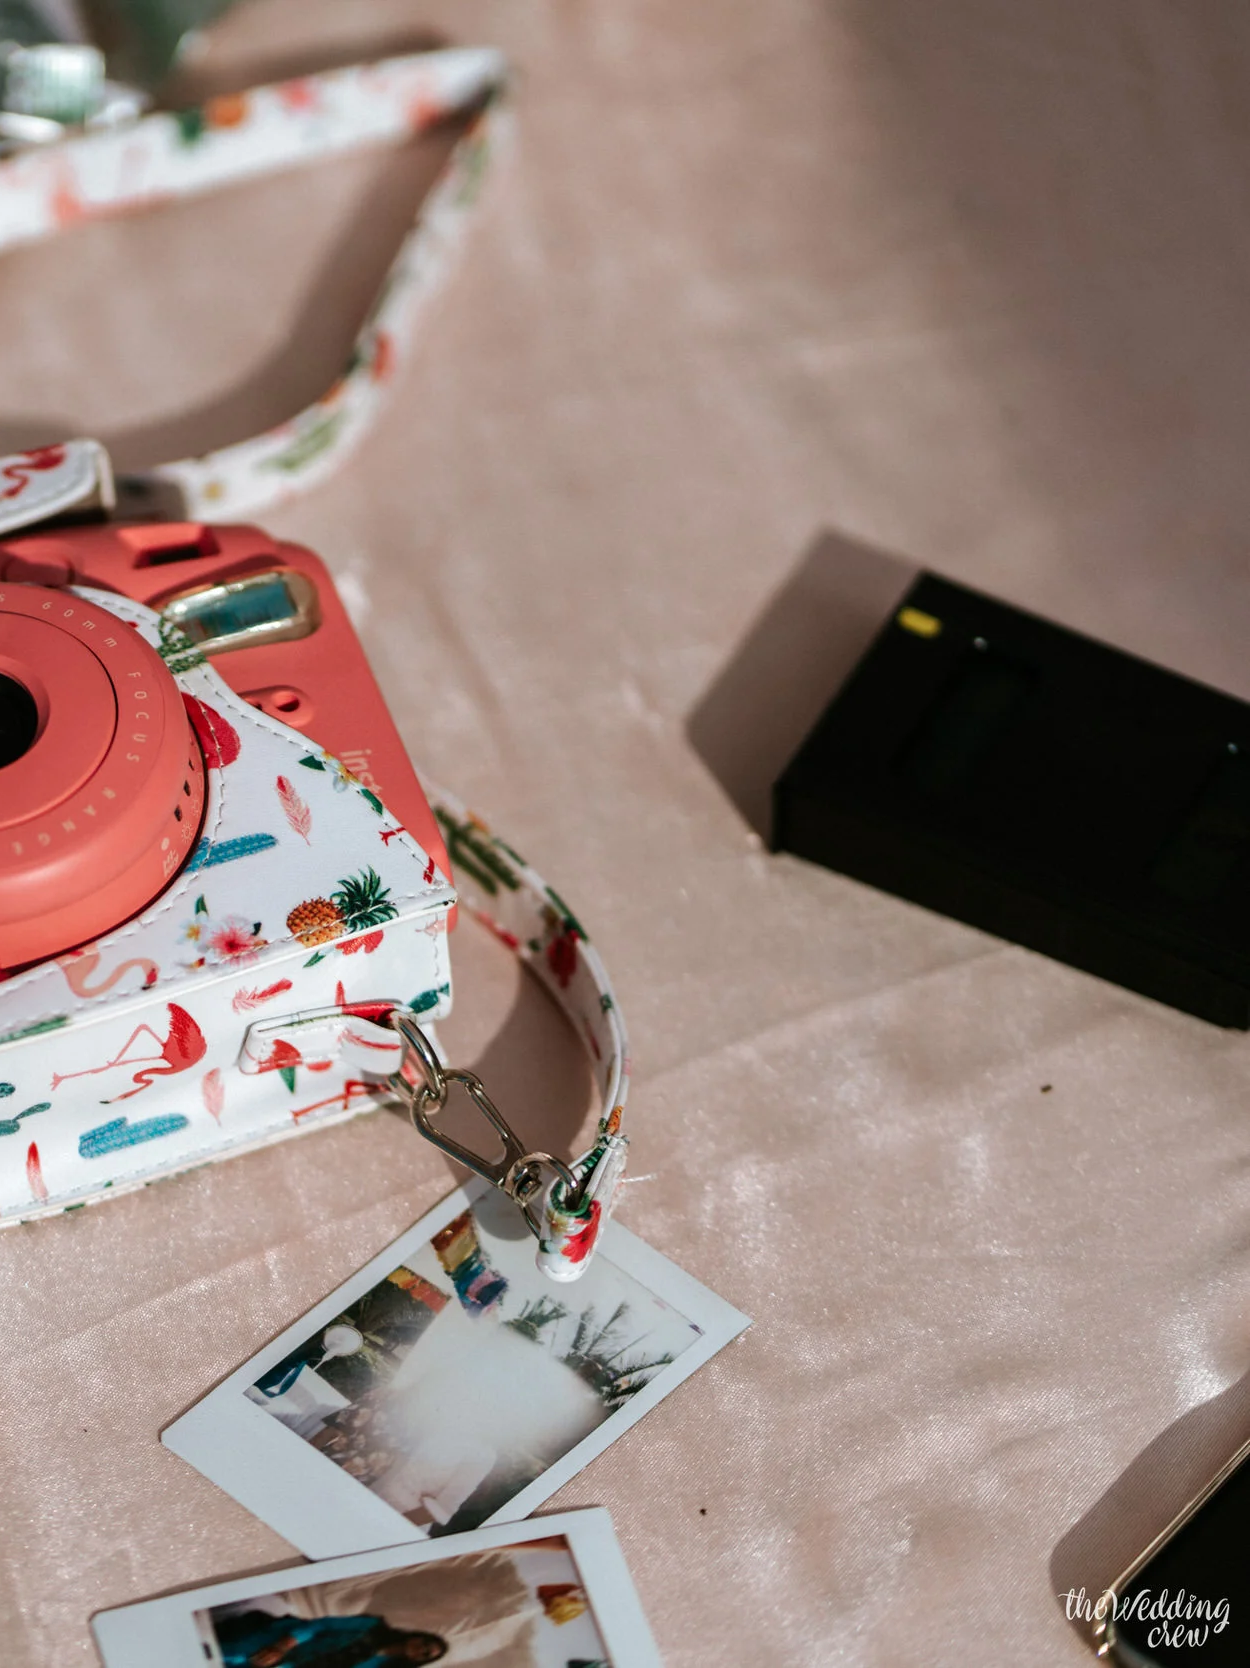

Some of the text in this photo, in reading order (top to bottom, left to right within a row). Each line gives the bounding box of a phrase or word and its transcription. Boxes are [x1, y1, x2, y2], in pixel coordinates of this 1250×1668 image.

[41, 601, 118, 648] 60mm
[126, 670, 150, 763] FOCUS
[12, 786, 116, 856] RANGE
